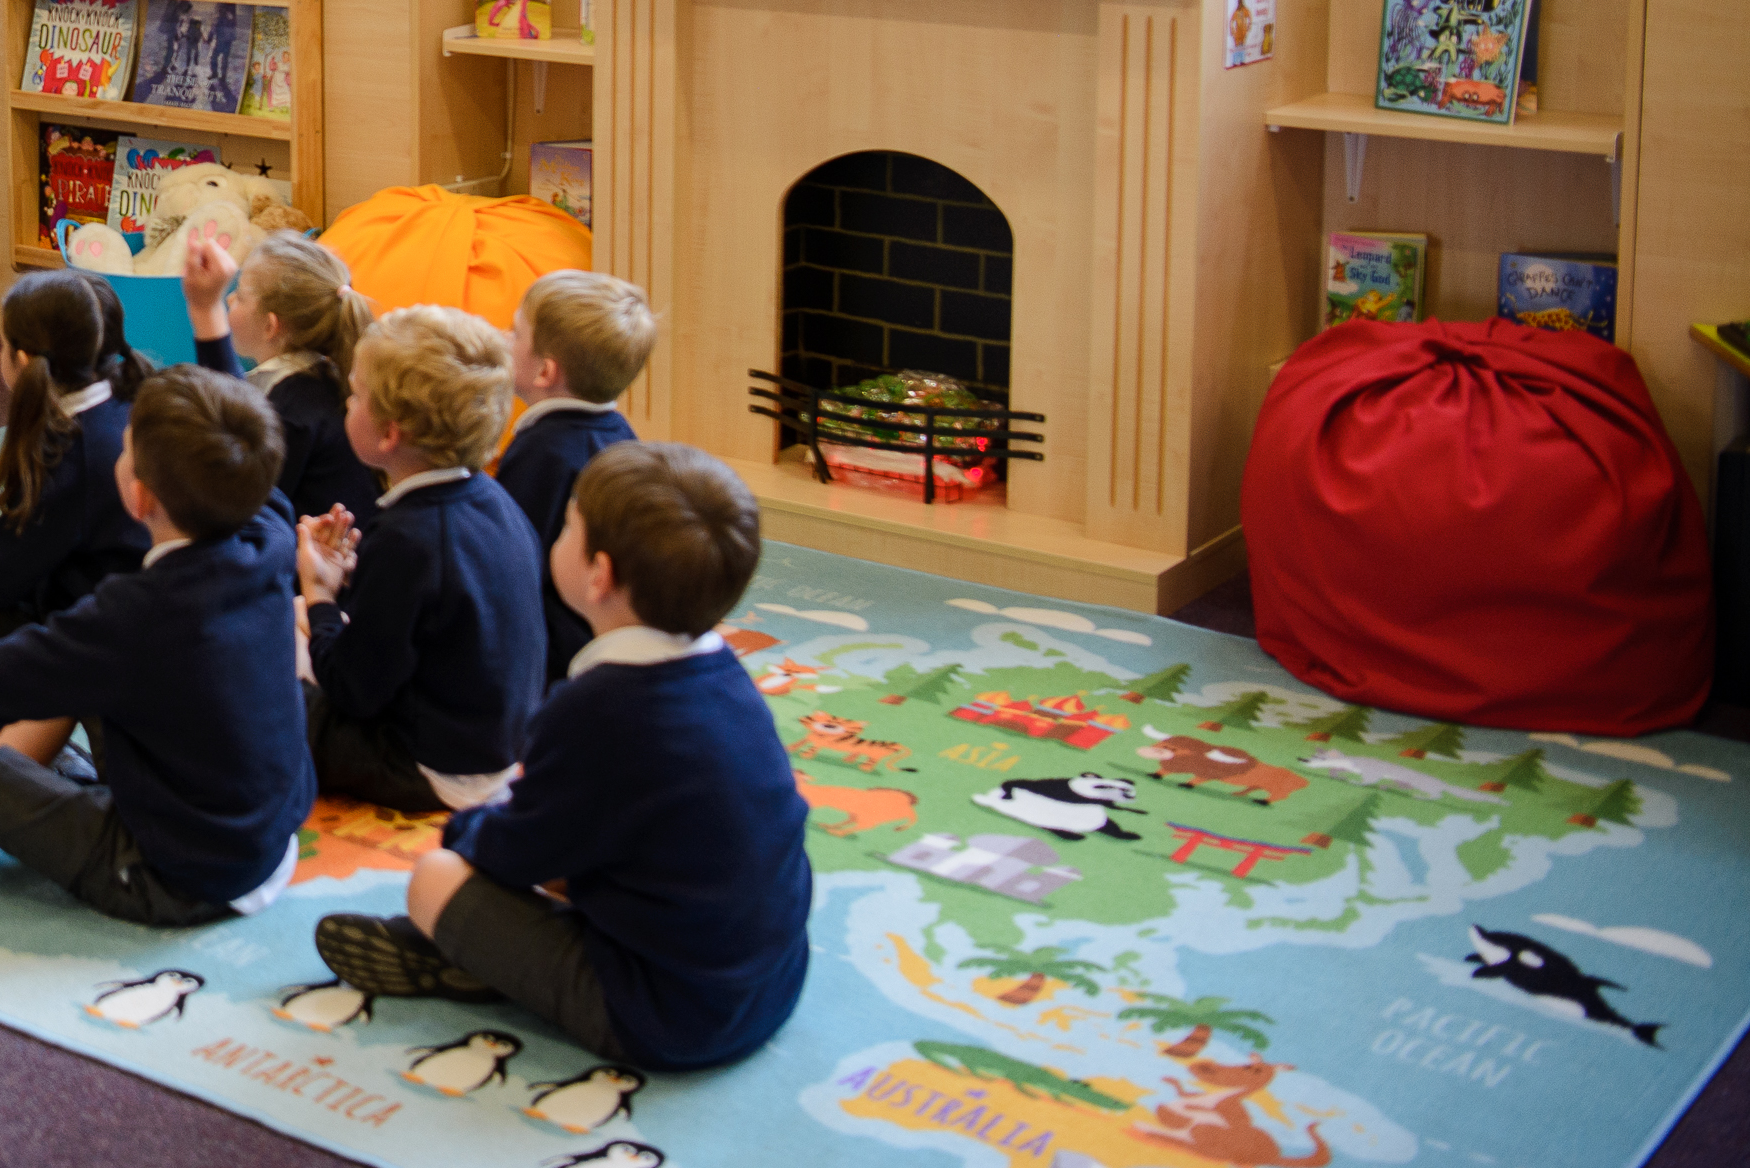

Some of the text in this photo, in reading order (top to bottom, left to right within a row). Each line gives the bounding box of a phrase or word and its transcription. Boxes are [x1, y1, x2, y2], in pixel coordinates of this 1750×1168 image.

[39, 24, 123, 60] DINOSAUR
[58, 179, 112, 207] PIRATE
[127, 172, 160, 190] KNOC
[1350, 247, 1392, 265] Leopard
[1350, 266, 1368, 283] Sky
[1527, 287, 1576, 301] DANCE
[938, 741, 1021, 774] ASIA
[1381, 997, 1548, 1067] PACIFIC
[1371, 1031, 1513, 1088] OCEAN
[190, 1036, 406, 1130] ANTARCTICA
[836, 1064, 1057, 1160] AUSTRALIA
